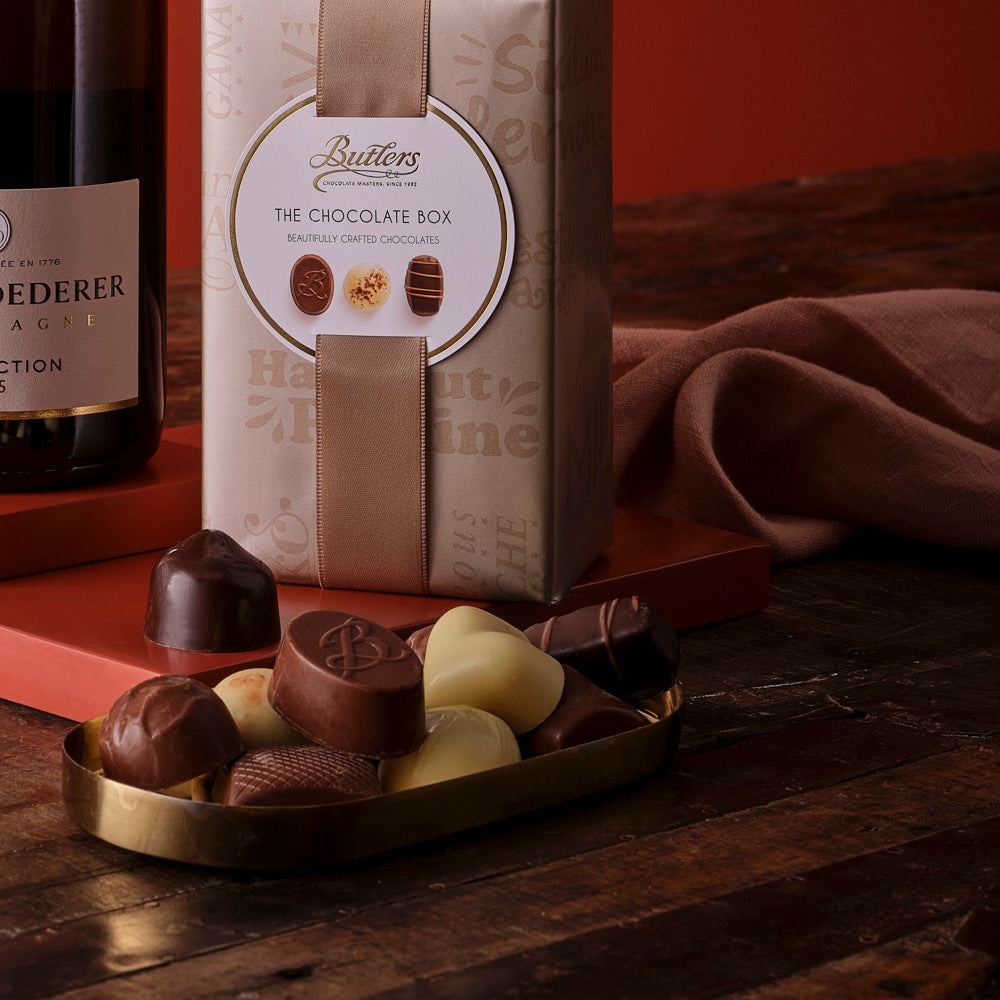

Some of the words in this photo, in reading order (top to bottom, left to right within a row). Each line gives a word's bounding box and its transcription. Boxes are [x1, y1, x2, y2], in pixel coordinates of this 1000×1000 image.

[309, 134, 420, 178] Butlers
[275, 208, 301, 222] THE
[308, 208, 410, 224] CHOCOLATE
[417, 210, 452, 224] BOX
[287, 234, 338, 244] BEAUTIFULLY
[340, 234, 377, 244] CRAFTED
[380, 235, 440, 245] CHOCOLATES
[39, 258, 61, 266] 1776
